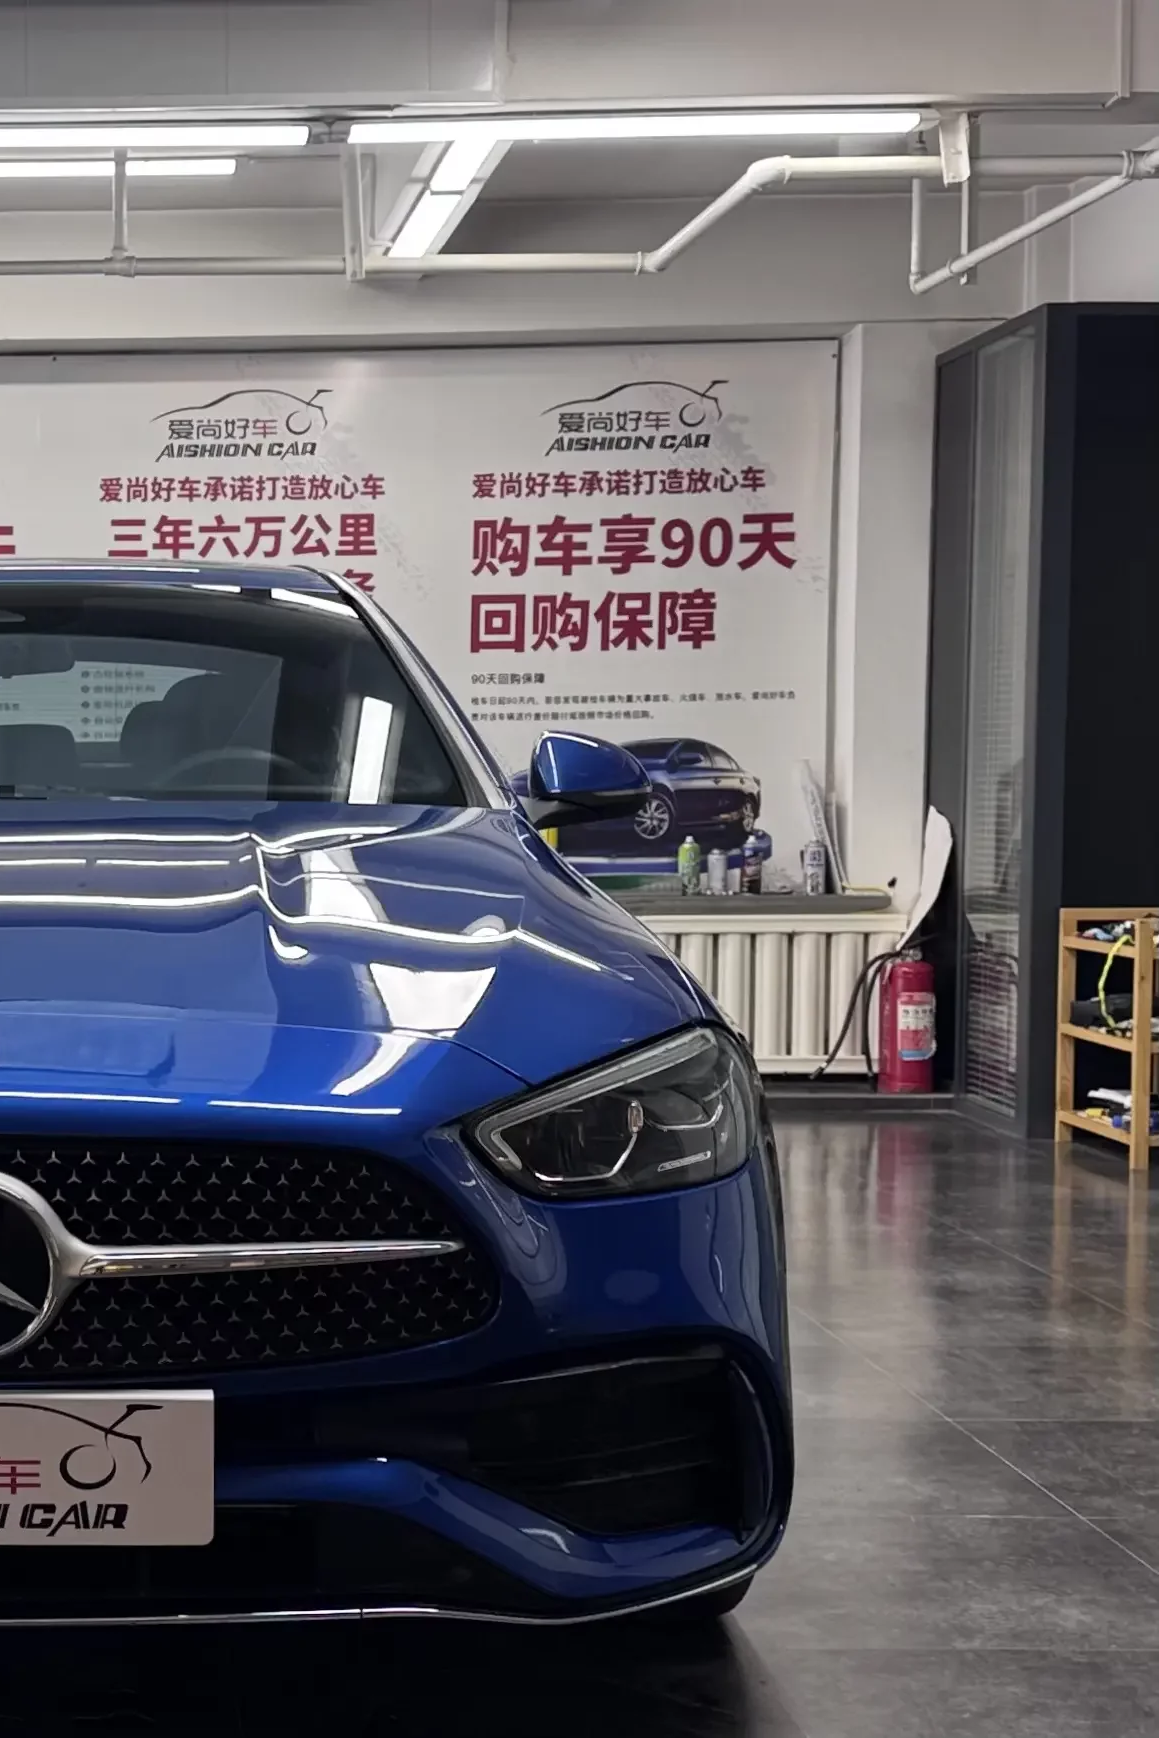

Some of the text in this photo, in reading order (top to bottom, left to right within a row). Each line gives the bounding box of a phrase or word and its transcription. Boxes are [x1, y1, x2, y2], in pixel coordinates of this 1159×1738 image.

[168, 418, 278, 440] 爱尚好车
[558, 411, 670, 433] 爱尚好车
[155, 441, 317, 462] AISHION CAR
[545, 433, 710, 456] AISHION CAR
[99, 474, 386, 503] 爱尚好车承诺打造放心车
[472, 466, 766, 499] 爱尚好车承诺打造放心车
[108, 513, 378, 559] 三年六万公里
[471, 512, 797, 577] 购车享90天
[470, 588, 717, 653] 回购保障
[471, 673, 545, 684] 90天回购保障
[19, 1500, 129, 1537] CAR
